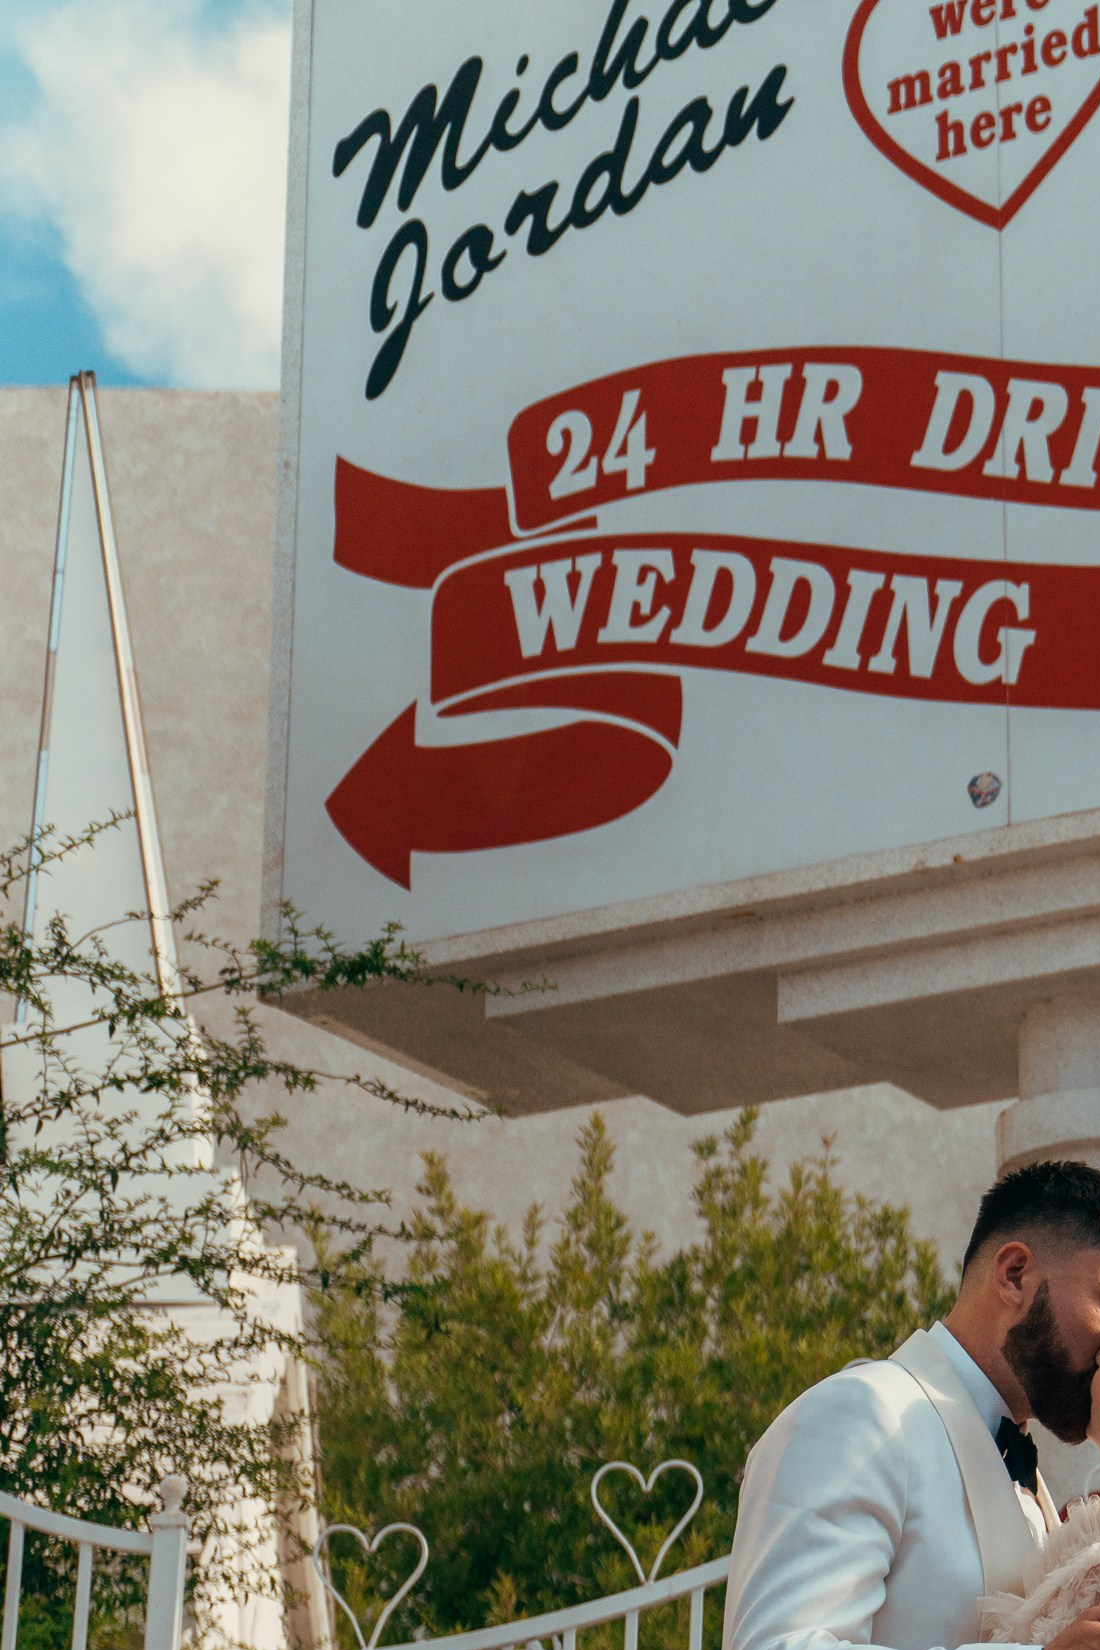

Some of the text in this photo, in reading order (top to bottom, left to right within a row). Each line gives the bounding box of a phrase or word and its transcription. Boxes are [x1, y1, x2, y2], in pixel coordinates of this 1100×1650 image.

[929, 0, 1049, 39] wer
[936, 95, 1052, 161] here
[366, 64, 794, 400] Jordan
[546, 389, 656, 500] 24
[711, 362, 863, 462] HR
[503, 548, 1036, 685] WEDDING
